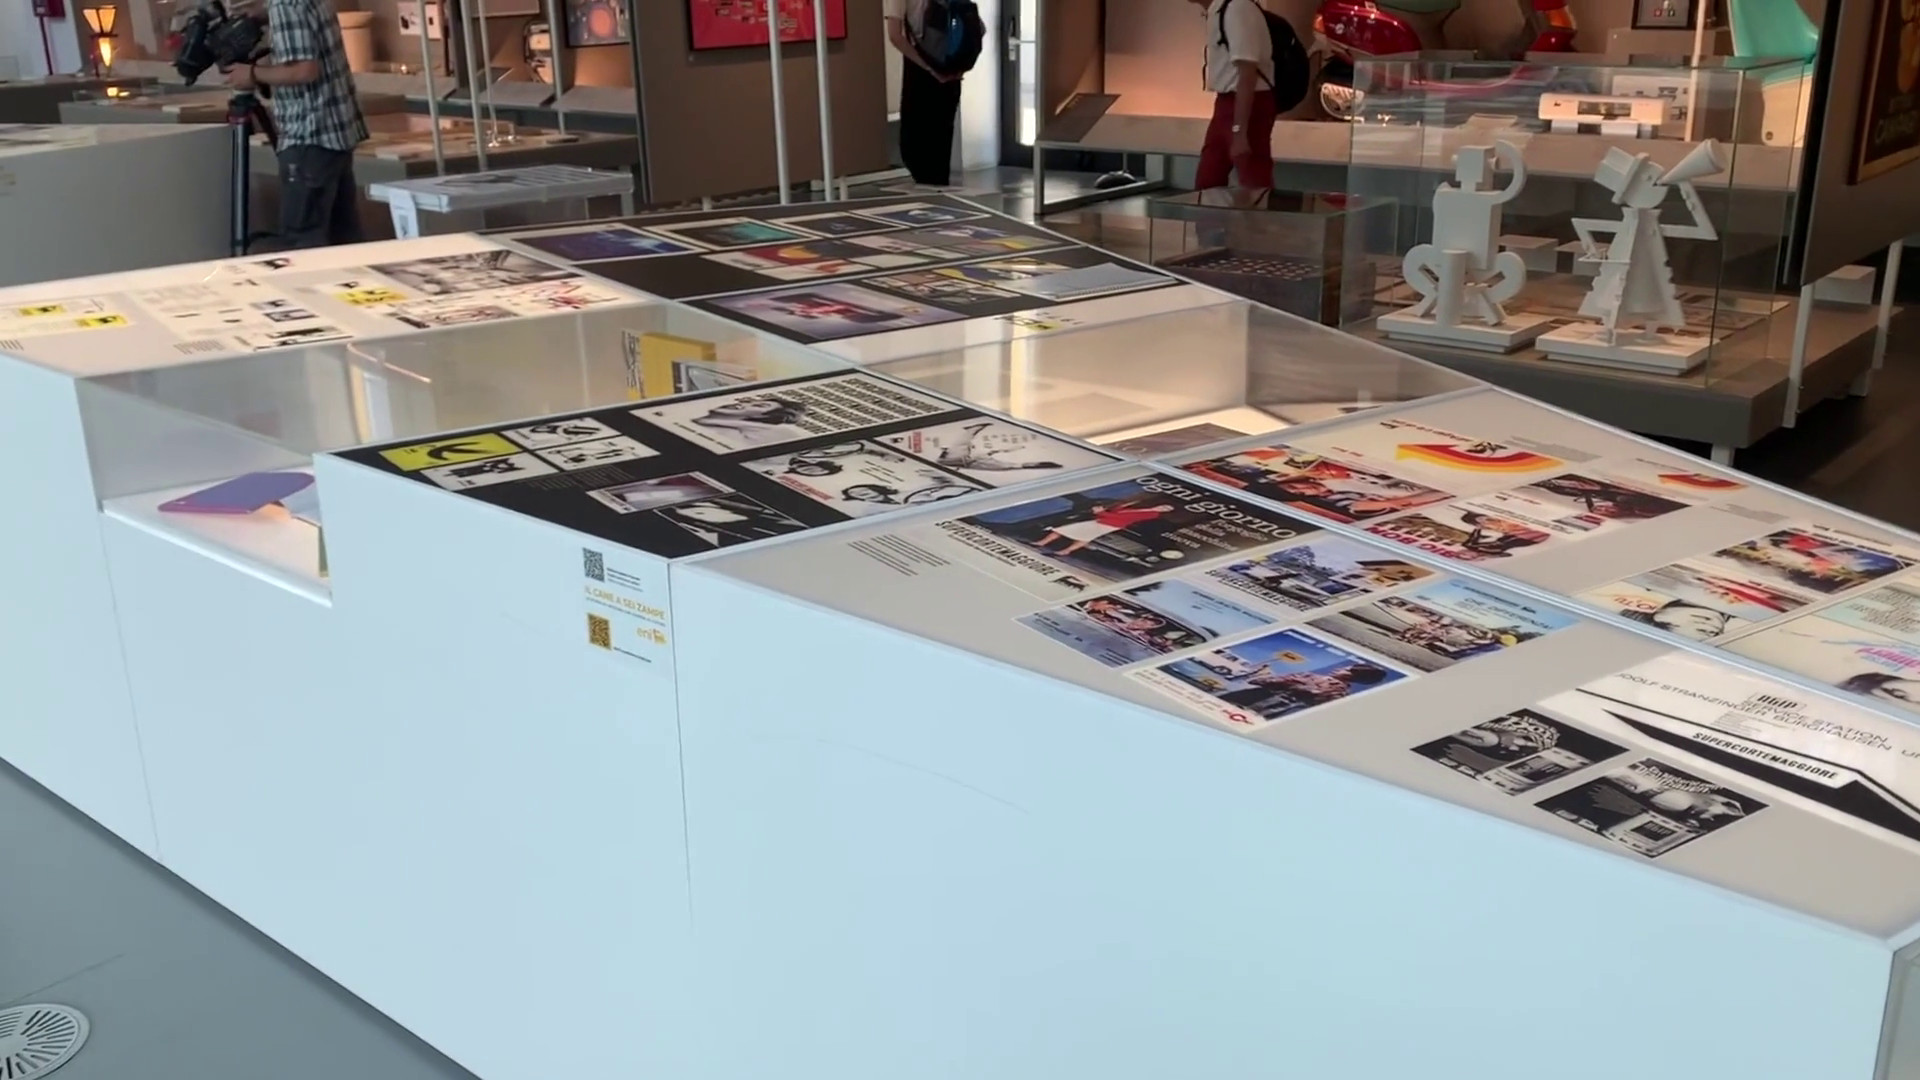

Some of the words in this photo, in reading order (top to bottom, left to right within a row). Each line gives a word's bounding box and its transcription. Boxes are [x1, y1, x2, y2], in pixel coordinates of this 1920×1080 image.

[1136, 476, 1210, 501] ogni
[1184, 500, 1297, 539] giorno
[1739, 700, 1806, 721] SERVICE
[1812, 718, 1888, 743] STATION
[1693, 731, 1839, 779] SUPERCORTEMAGGIORE
